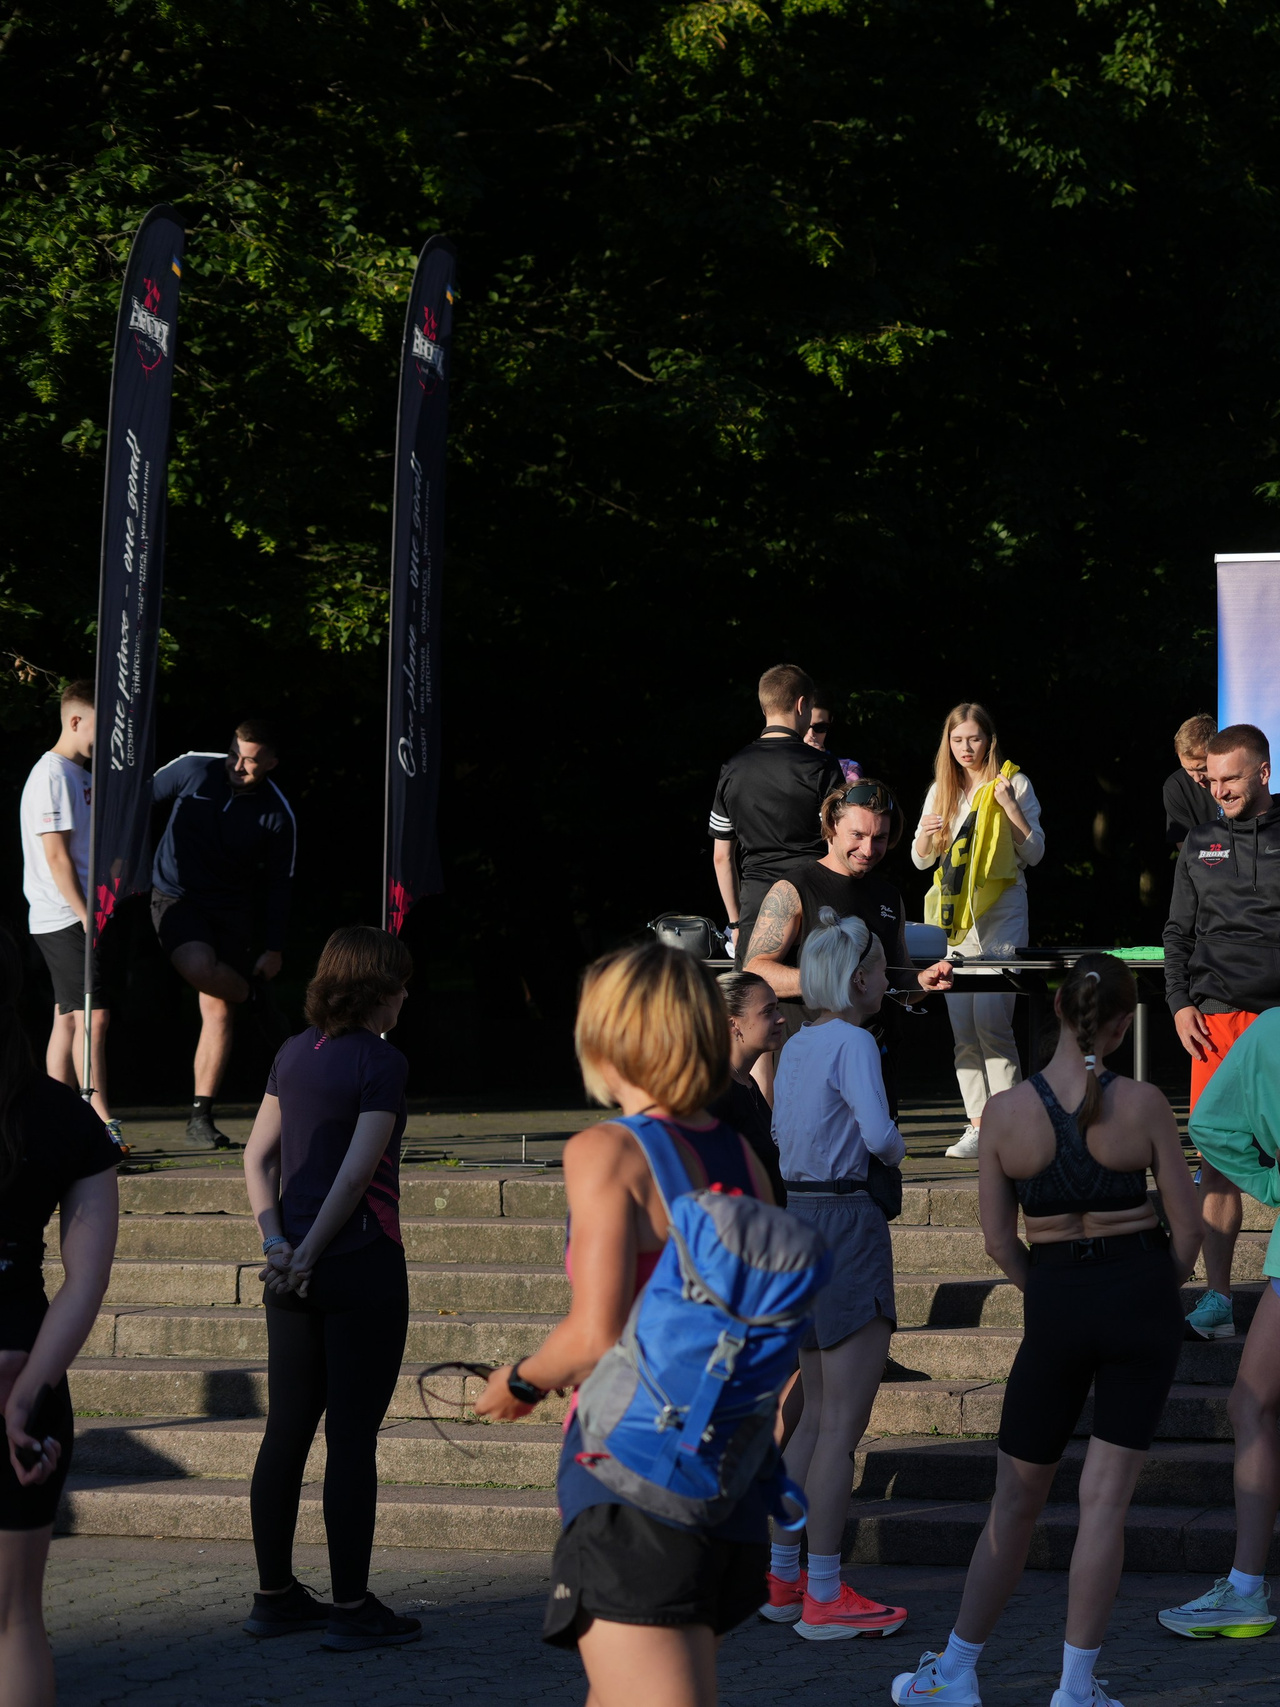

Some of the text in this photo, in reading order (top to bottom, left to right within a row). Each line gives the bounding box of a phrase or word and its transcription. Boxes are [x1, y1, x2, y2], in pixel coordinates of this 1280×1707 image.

[123, 516, 135, 573] one
[127, 718, 135, 767] CROSSFIT
[140, 460, 150, 540] WEIGHTLIFTING
[1198, 849, 1230, 859] BRONX
